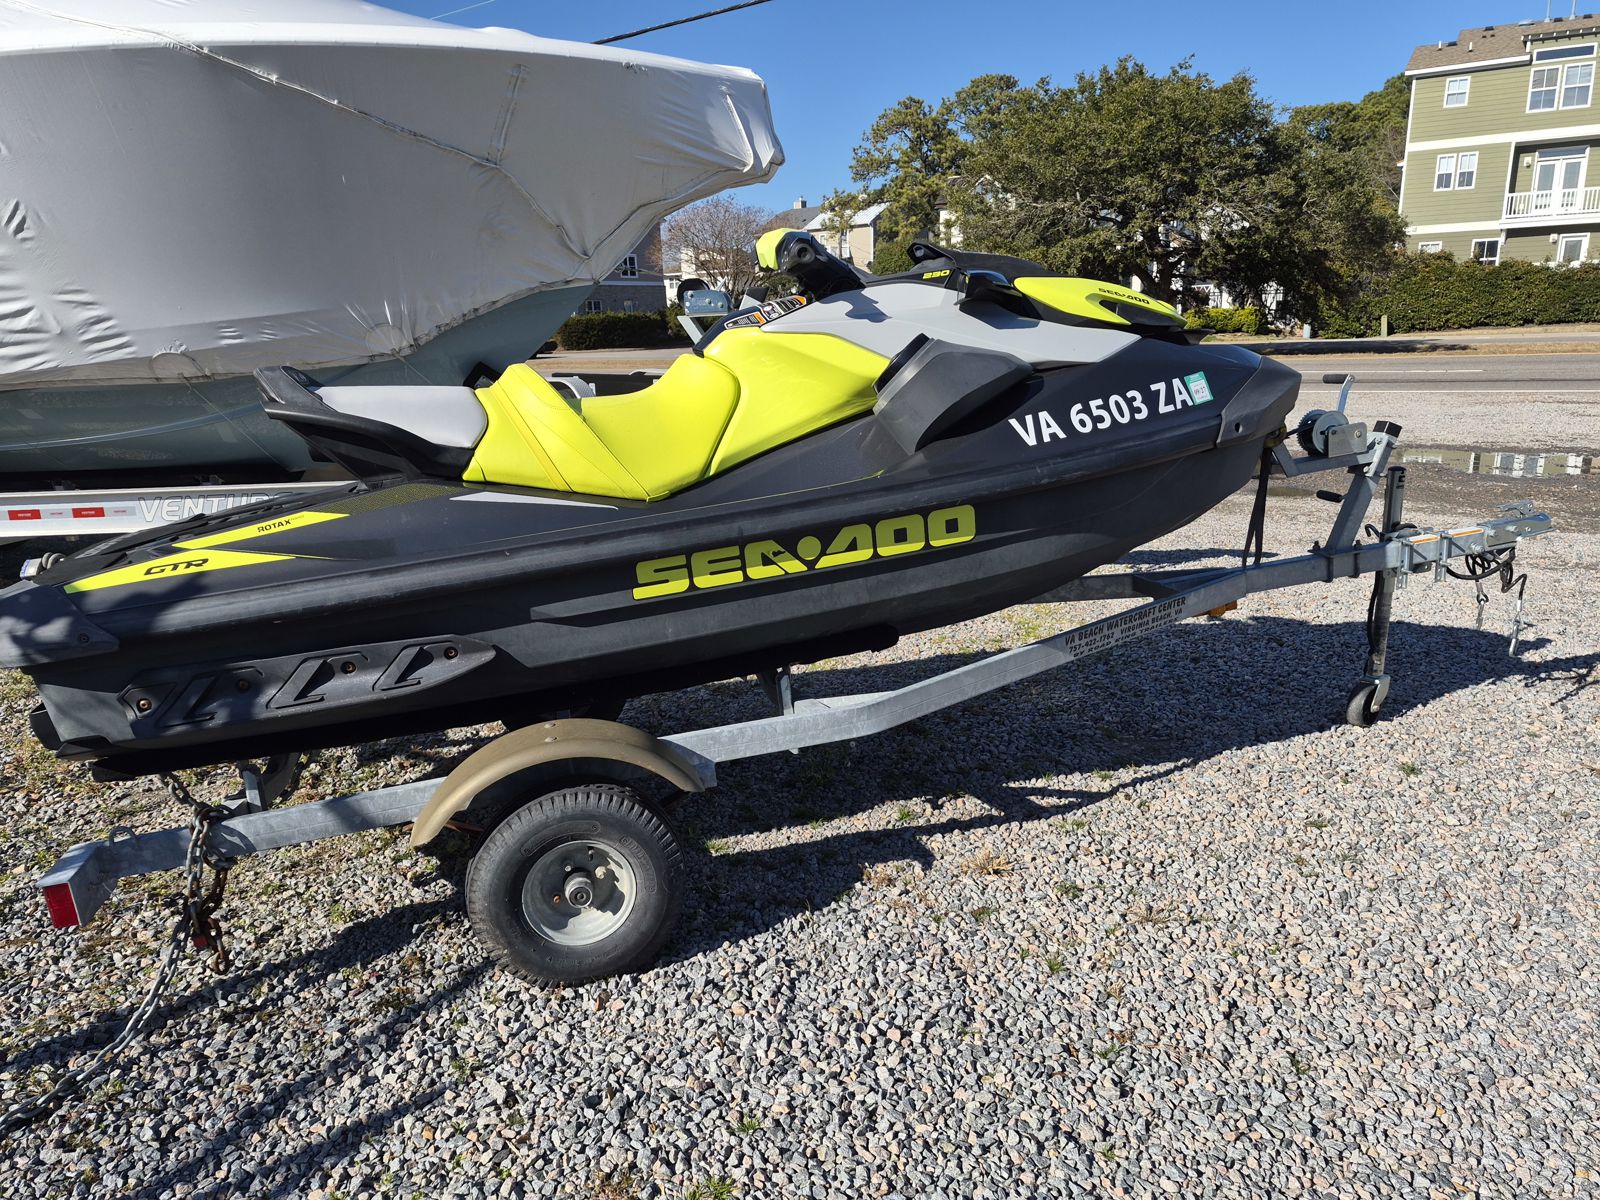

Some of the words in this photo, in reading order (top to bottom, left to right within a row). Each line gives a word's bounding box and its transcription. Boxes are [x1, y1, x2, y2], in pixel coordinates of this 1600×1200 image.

[922, 269, 950, 279] 230
[1007, 410, 1067, 447] VA
[1070, 389, 1149, 434] 6503
[1149, 377, 1194, 414] ZA
[256, 518, 292, 533] ROTAX
[144, 558, 209, 576] GTR
[1065, 634, 1076, 646] VA
[1078, 624, 1105, 641] BEACH
[1106, 606, 1157, 631] WATERCRAFT
[1157, 596, 1186, 614] CENTER
[1120, 619, 1150, 635] VIRGINIA
